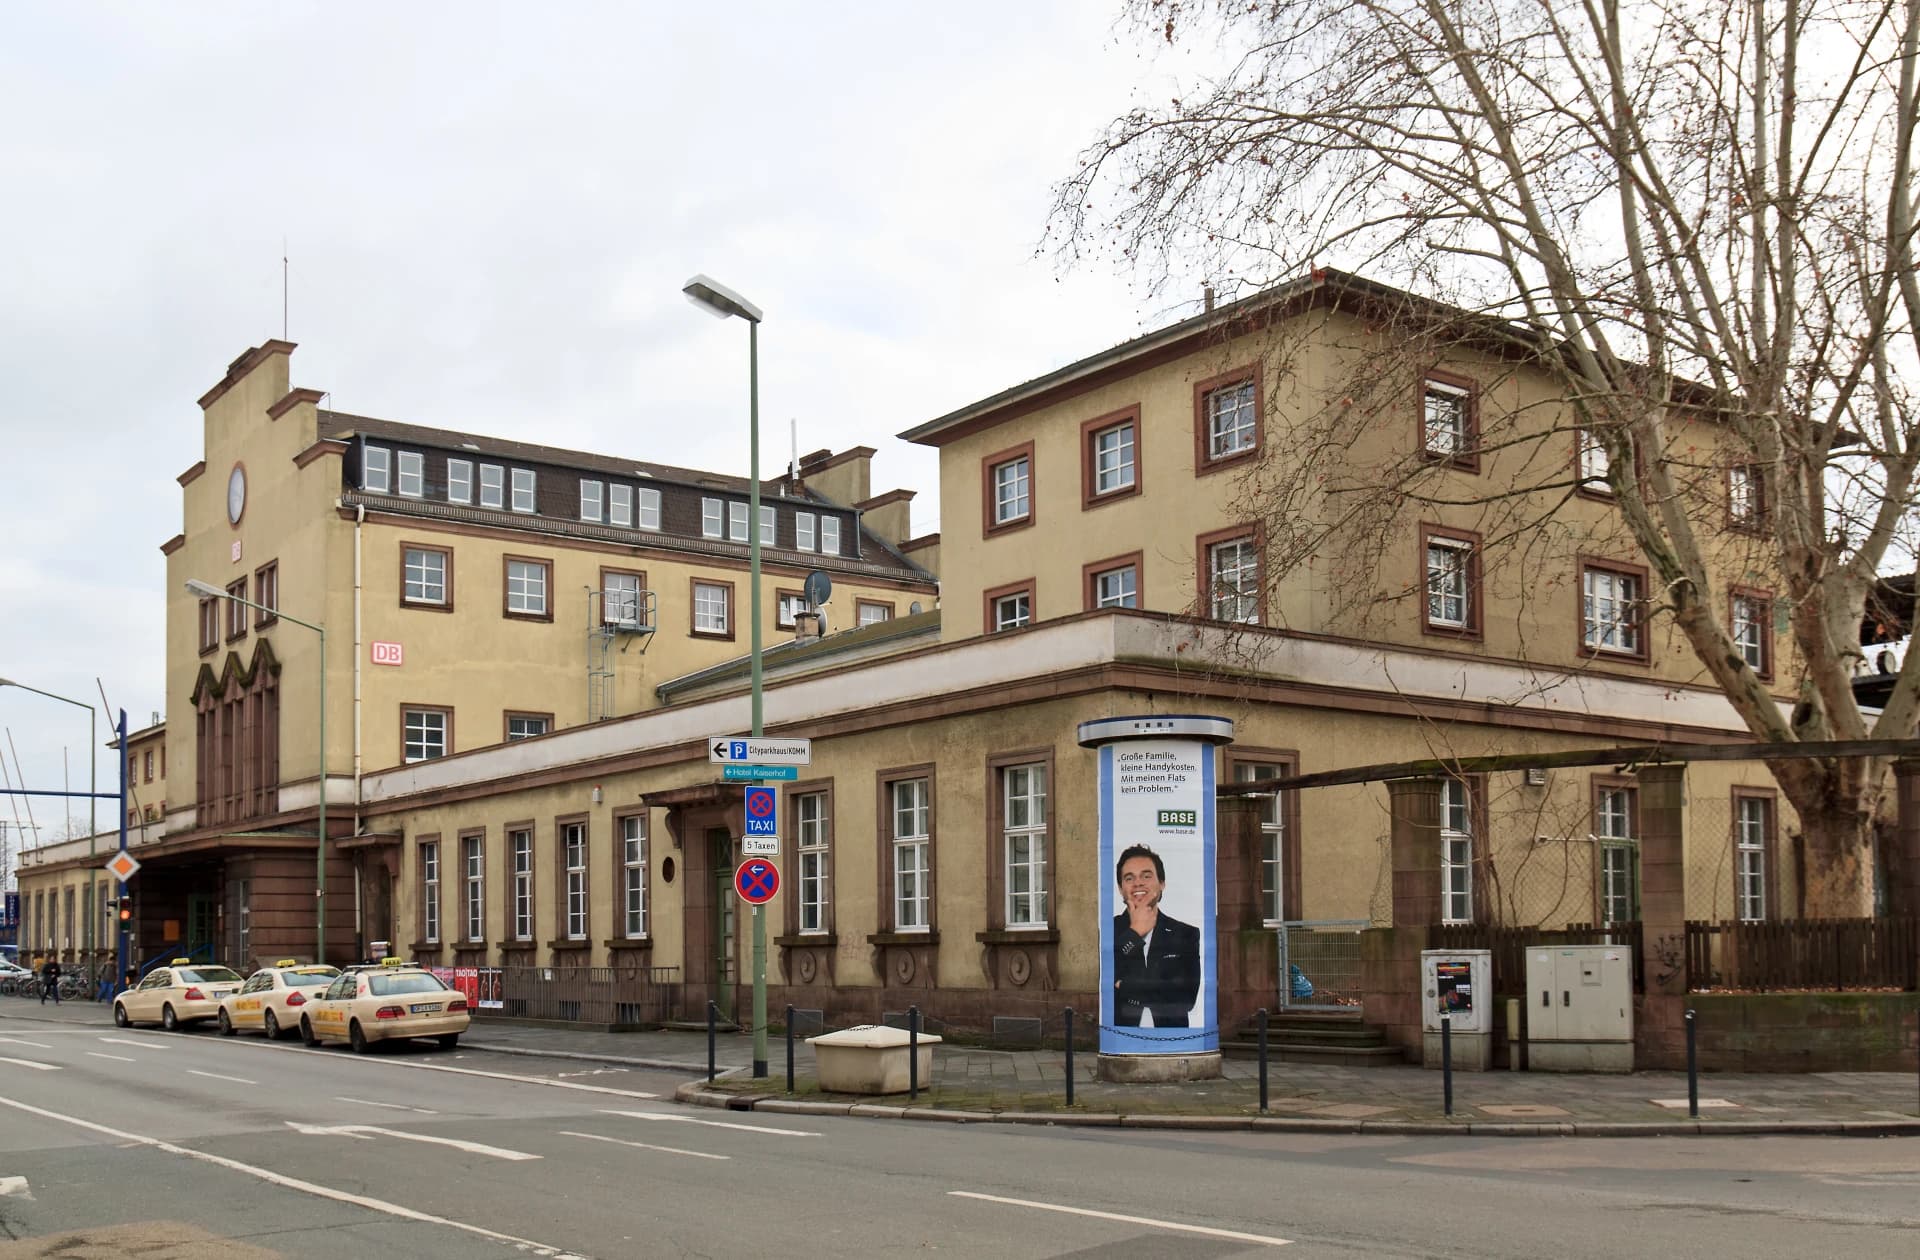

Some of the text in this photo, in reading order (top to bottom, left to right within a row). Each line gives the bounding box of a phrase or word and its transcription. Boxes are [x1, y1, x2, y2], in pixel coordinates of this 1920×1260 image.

[376, 644, 399, 661] DB
[1145, 752, 1177, 761] Familie,
[1121, 764, 1143, 772] kleine
[753, 769, 786, 777] Kaiserhof
[1121, 773, 1186, 783] Mit meinen Flats
[1121, 786, 1136, 794] kein
[1161, 812, 1194, 823] BASE
[748, 820, 774, 830] TAXI
[747, 841, 776, 850] 5 Taxen
[467, 969, 478, 977] TAO
